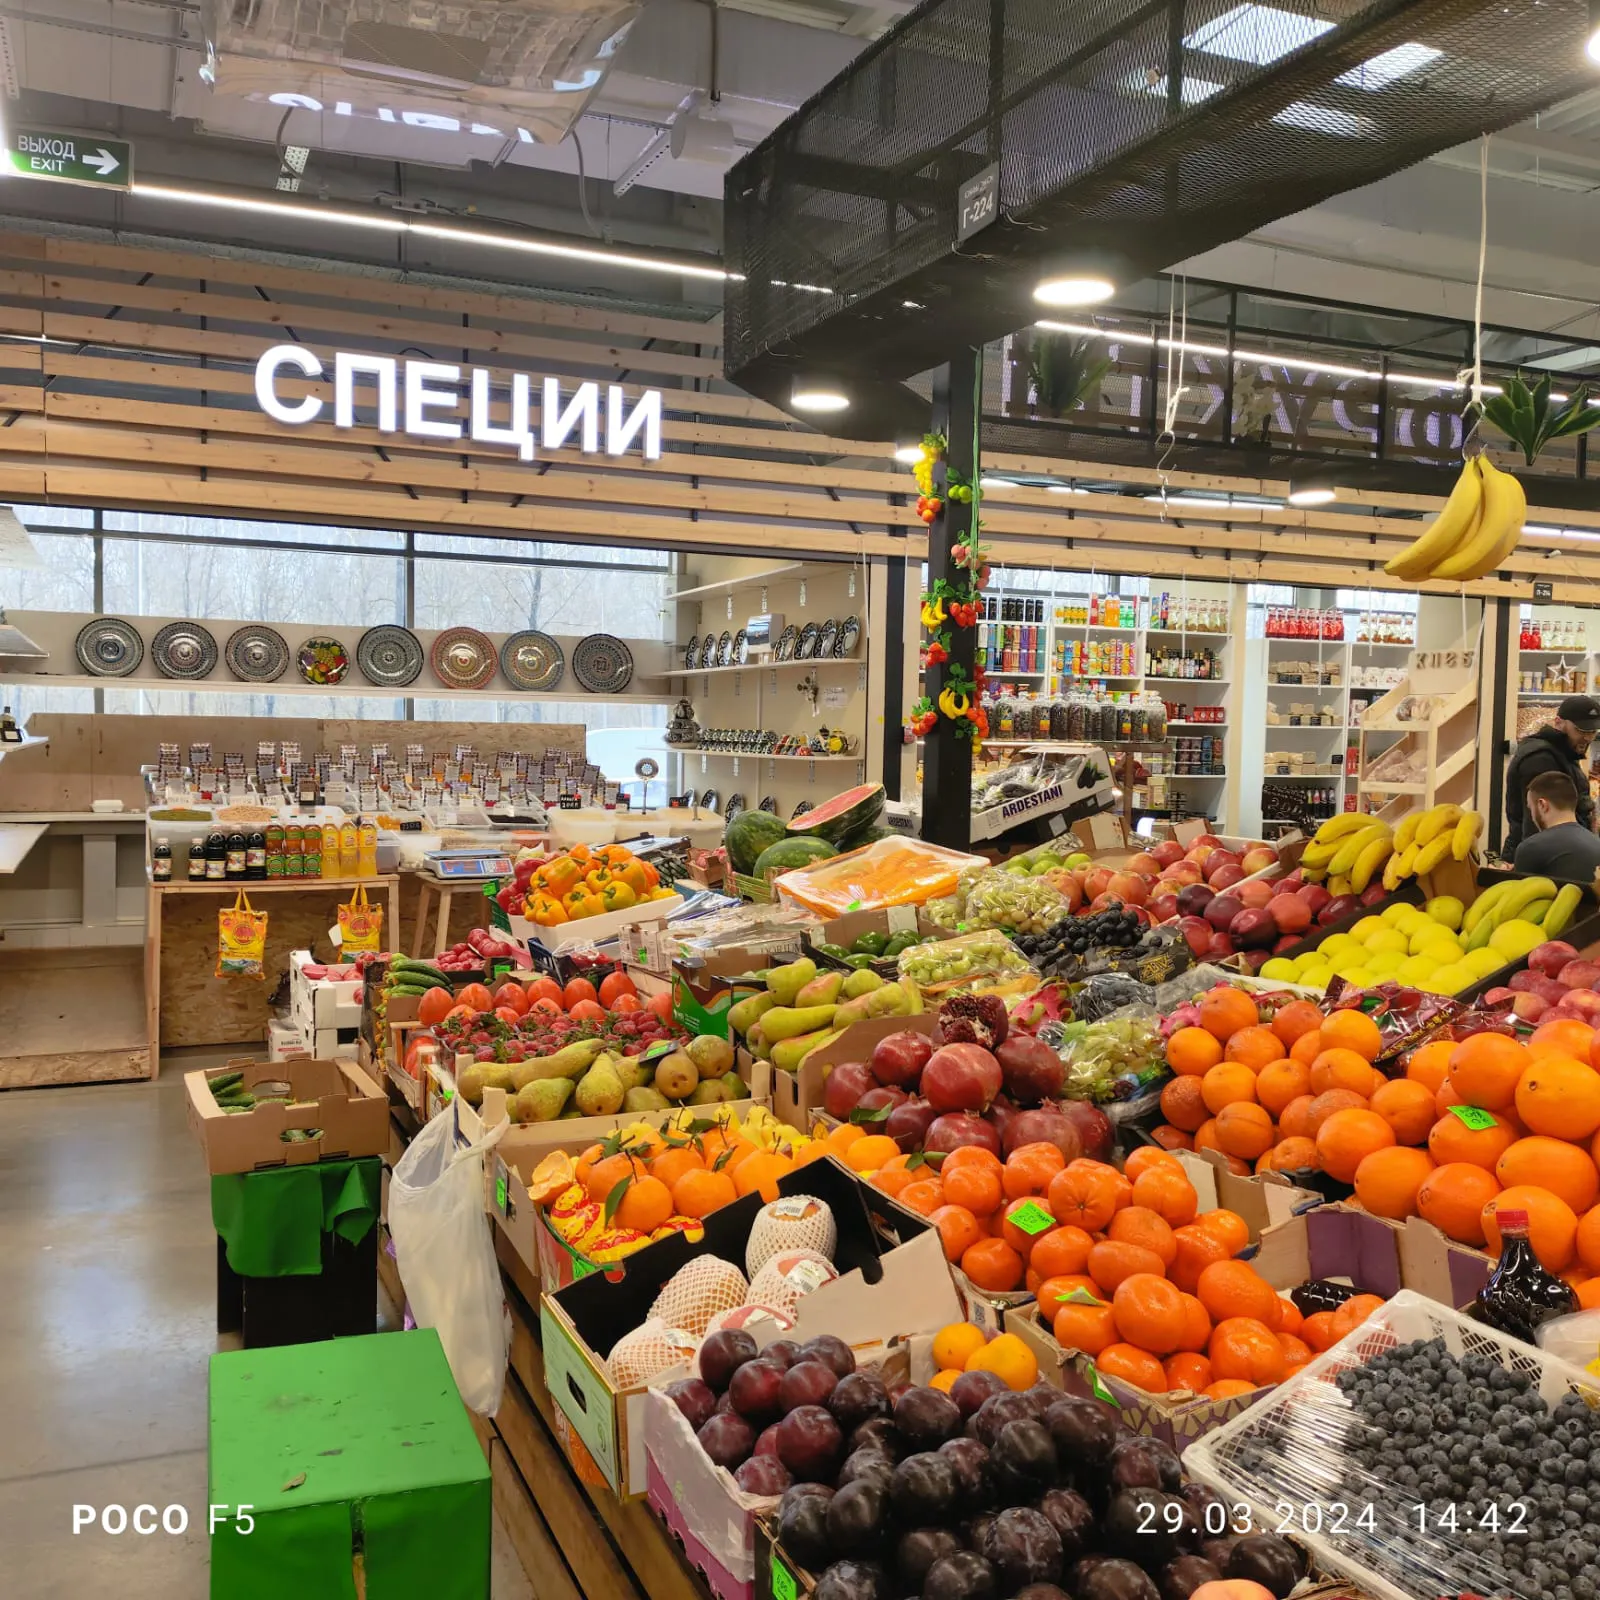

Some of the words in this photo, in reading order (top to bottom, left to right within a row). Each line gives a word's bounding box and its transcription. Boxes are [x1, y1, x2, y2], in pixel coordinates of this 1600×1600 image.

[17, 134, 76, 160] ВЫХОД
[30, 156, 65, 172] EXIT
[963, 191, 993, 229] Г-224
[254, 344, 662, 462] СПЕЦИИ
[1002, 784, 1064, 818] ARDESTANI
